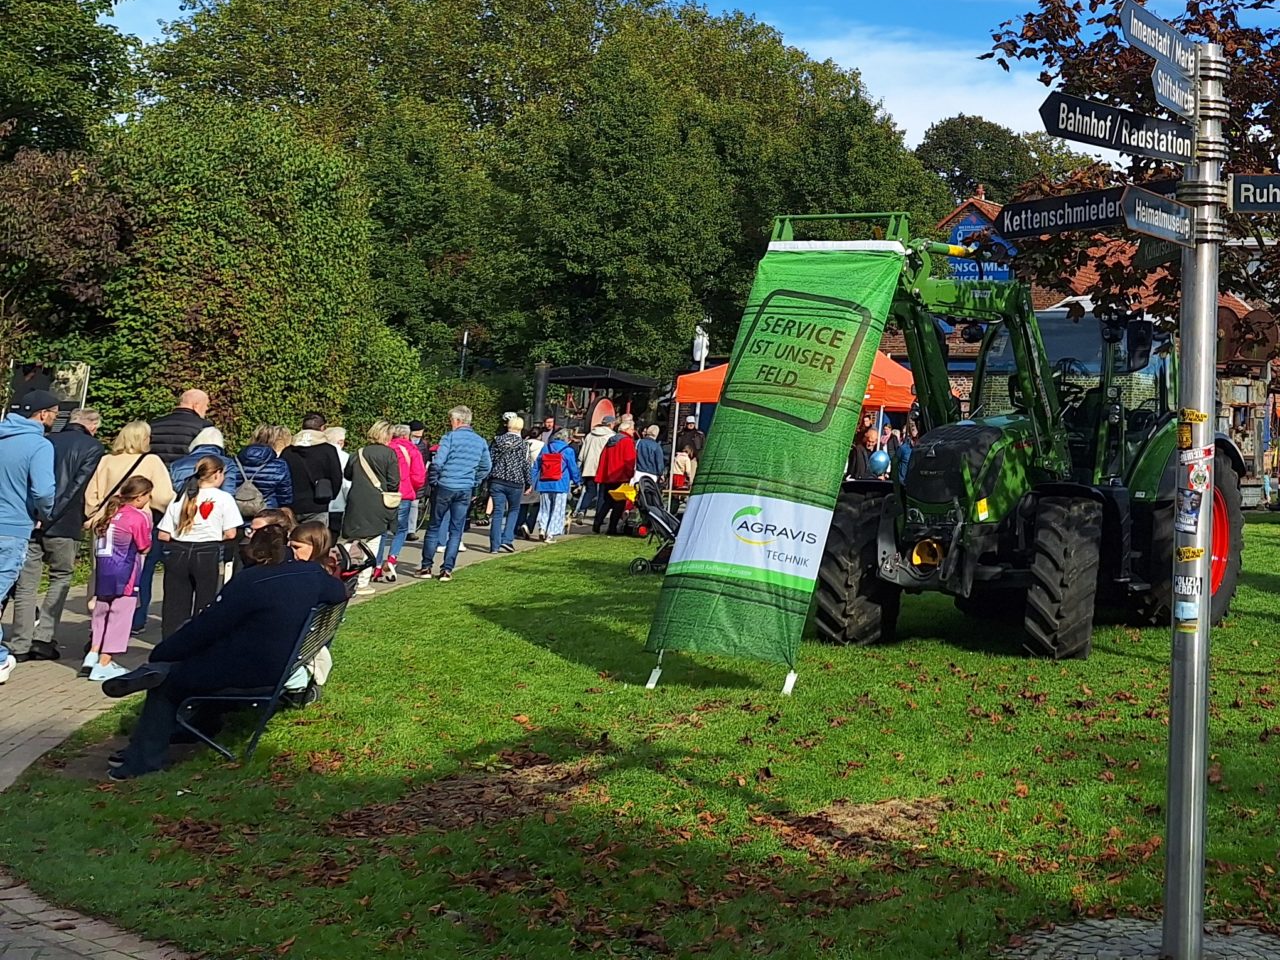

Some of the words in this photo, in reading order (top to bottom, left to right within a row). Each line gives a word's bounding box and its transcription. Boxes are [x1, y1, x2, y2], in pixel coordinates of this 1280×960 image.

[1130, 9, 1170, 58] Innenstadt
[1157, 69, 1195, 113] Stiftskirche
[1058, 102, 1112, 140] Bahnhof
[1121, 119, 1191, 157] Radstation
[1135, 198, 1191, 239] Heimatmuseum
[760, 316, 847, 349] SERVICE
[748, 338, 774, 356] IST
[774, 343, 836, 374] UNSER
[756, 364, 798, 387] FELD
[736, 520, 818, 545] AGRAVIS
[766, 549, 810, 568] TECHNIK
[1174, 575, 1201, 586] POLIZIA
